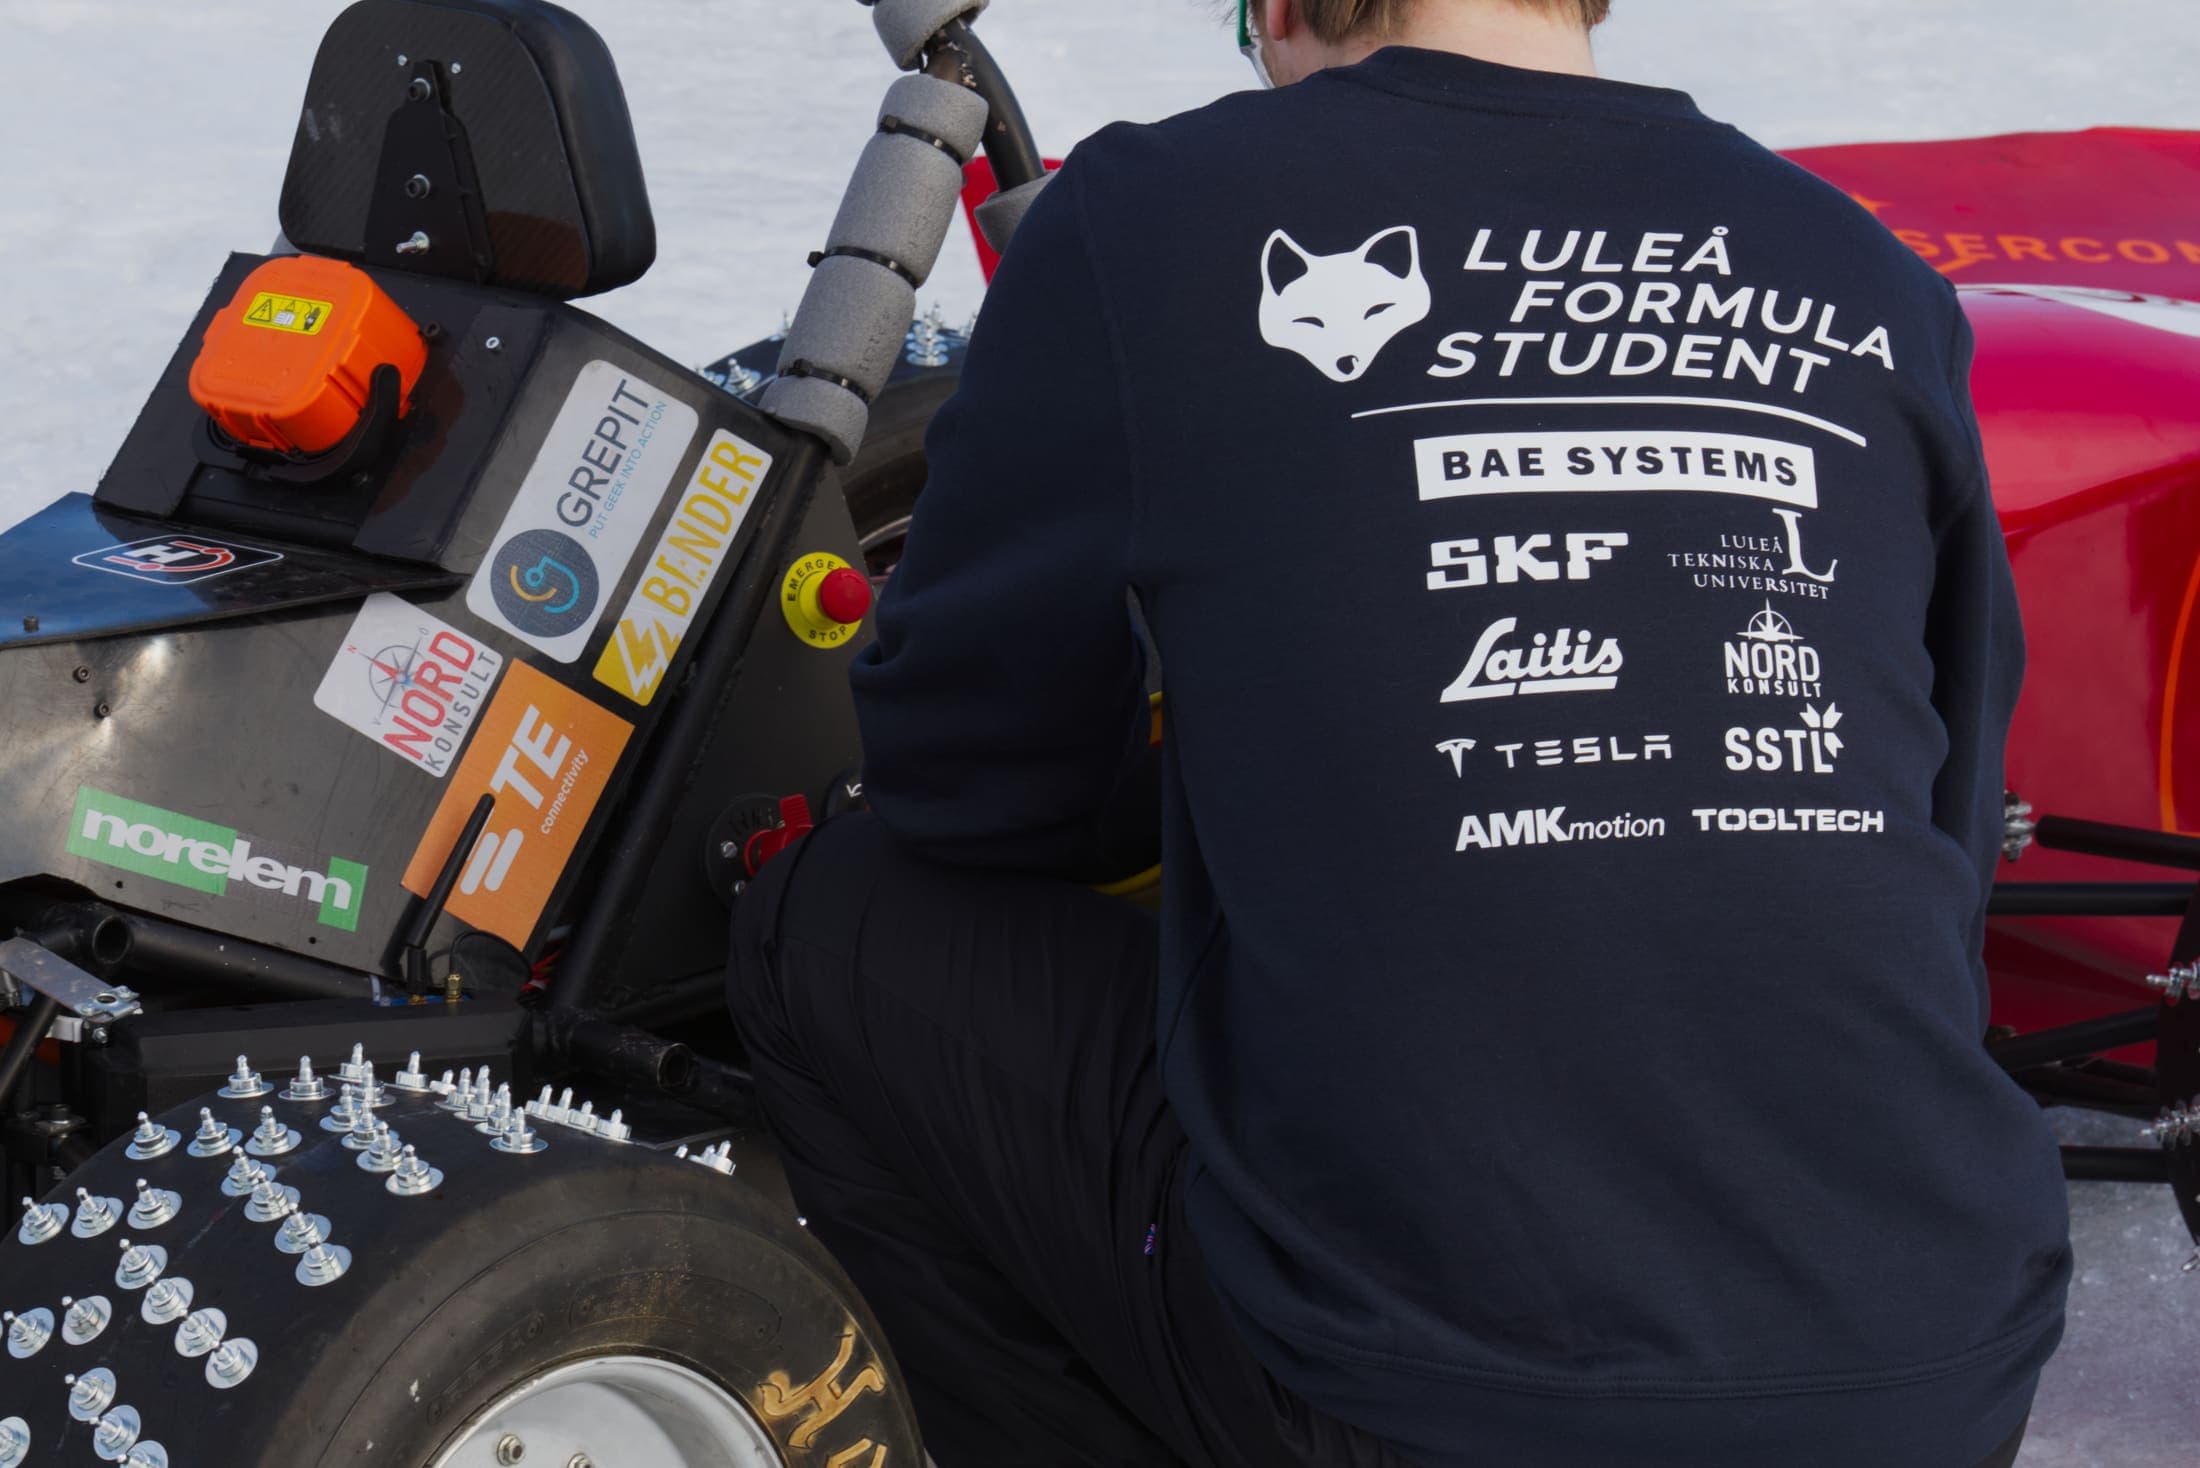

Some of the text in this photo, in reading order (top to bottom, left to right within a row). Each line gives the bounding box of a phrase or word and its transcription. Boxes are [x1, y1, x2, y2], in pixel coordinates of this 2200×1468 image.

[1463, 226, 1731, 275] LULEÅ
[1510, 281, 1894, 370] FORMULA
[1427, 332, 1831, 393] STUDENT
[556, 379, 649, 527] GREPIT
[588, 400, 668, 539] PUT GEEK INTO ACTION
[1442, 446, 1797, 486] BAE SYSTEMS
[1426, 532, 1629, 591] SKF
[1667, 552, 1774, 572] TEKNISKA
[1720, 534, 1783, 554] LULEÅ
[787, 558, 836, 601] EMERGE
[1693, 574, 1829, 599] UNIVERSITET
[808, 625, 846, 642] STOP
[1440, 617, 1624, 702] Laitis
[1723, 641, 1821, 682] NORD
[384, 631, 475, 760] NORD
[424, 651, 495, 772] KONSULT
[1727, 678, 1822, 698] KONSULT
[489, 703, 572, 810] TE
[1494, 734, 1672, 768] TESLA
[1724, 726, 1834, 774] SSTL
[540, 749, 589, 835] connectivity
[1691, 807, 1884, 833] TOOLTECH
[82, 808, 353, 910] norelem
